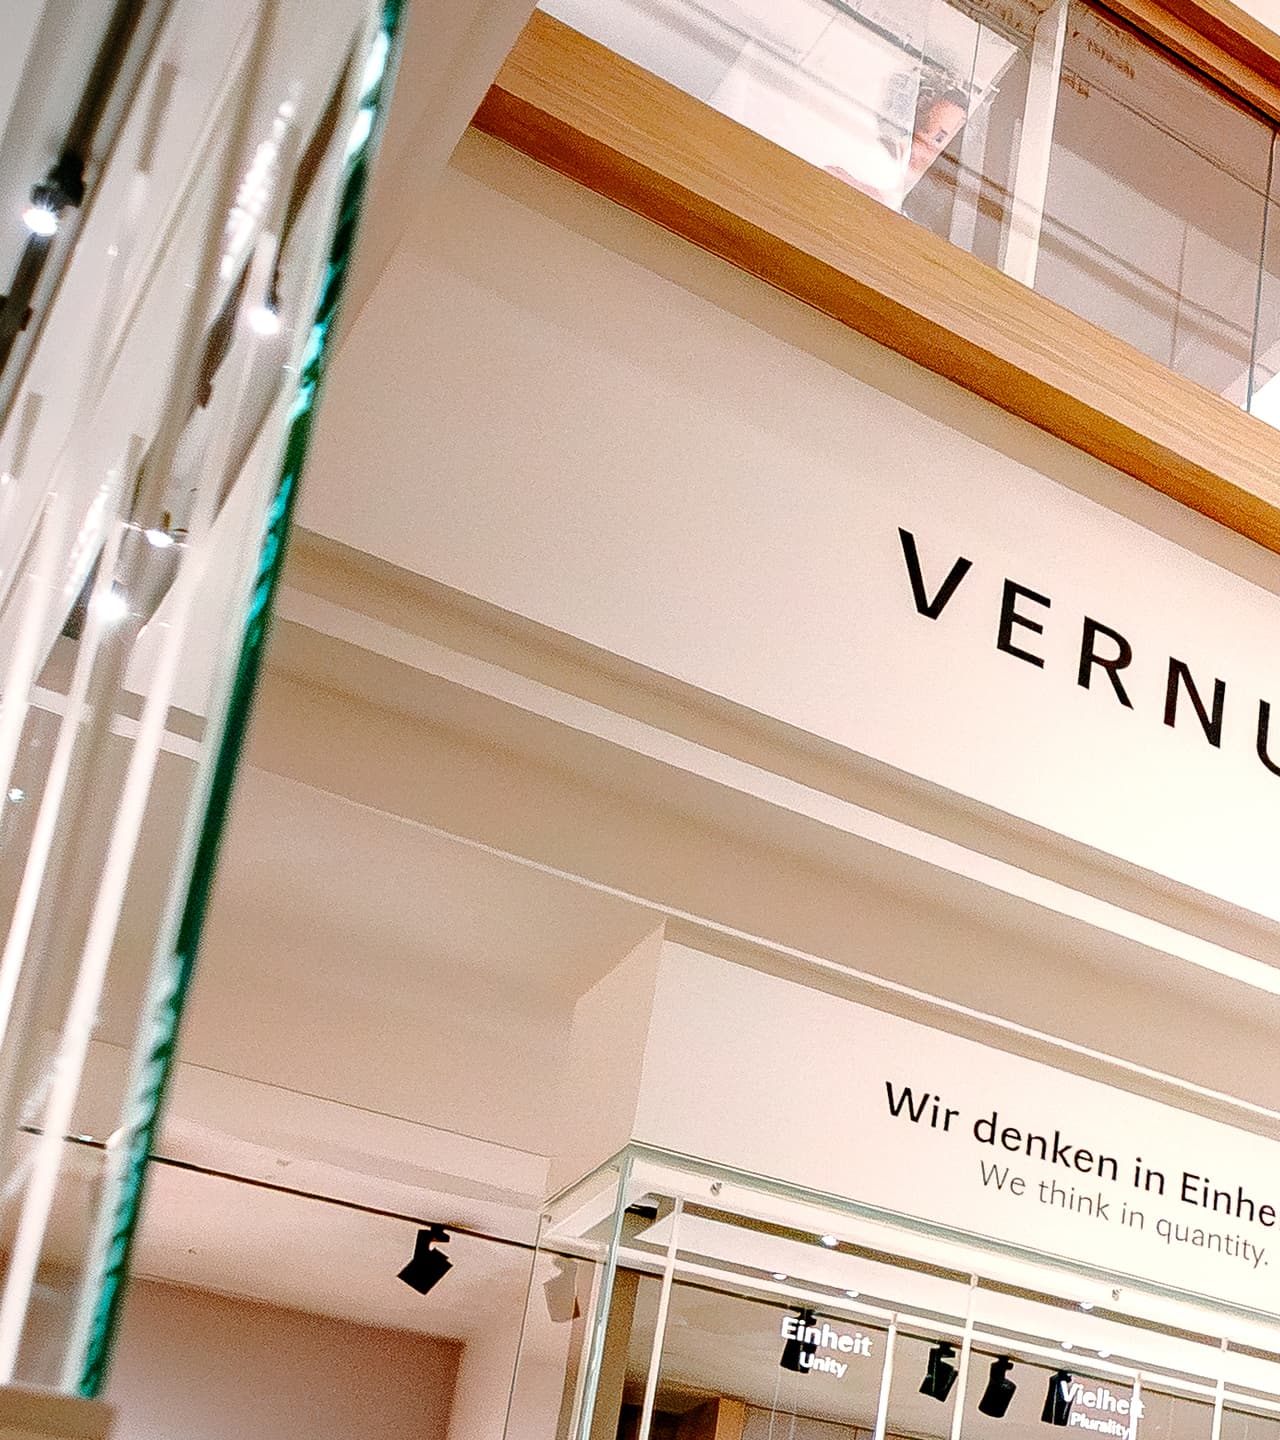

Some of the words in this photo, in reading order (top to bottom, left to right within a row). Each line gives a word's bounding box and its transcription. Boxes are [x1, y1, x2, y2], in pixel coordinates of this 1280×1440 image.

[883, 1079, 961, 1135] Wir
[971, 1109, 1121, 1186] denken
[1132, 1155, 1167, 1197] in
[978, 1157, 1026, 1198] We
[1037, 1176, 1110, 1222] think
[1119, 1197, 1147, 1231] in
[1154, 1206, 1271, 1268] quantity.
[780, 1315, 873, 1359] Einheit
[799, 1350, 849, 1379] Unity
[1070, 1412, 1131, 1440] Plurality
